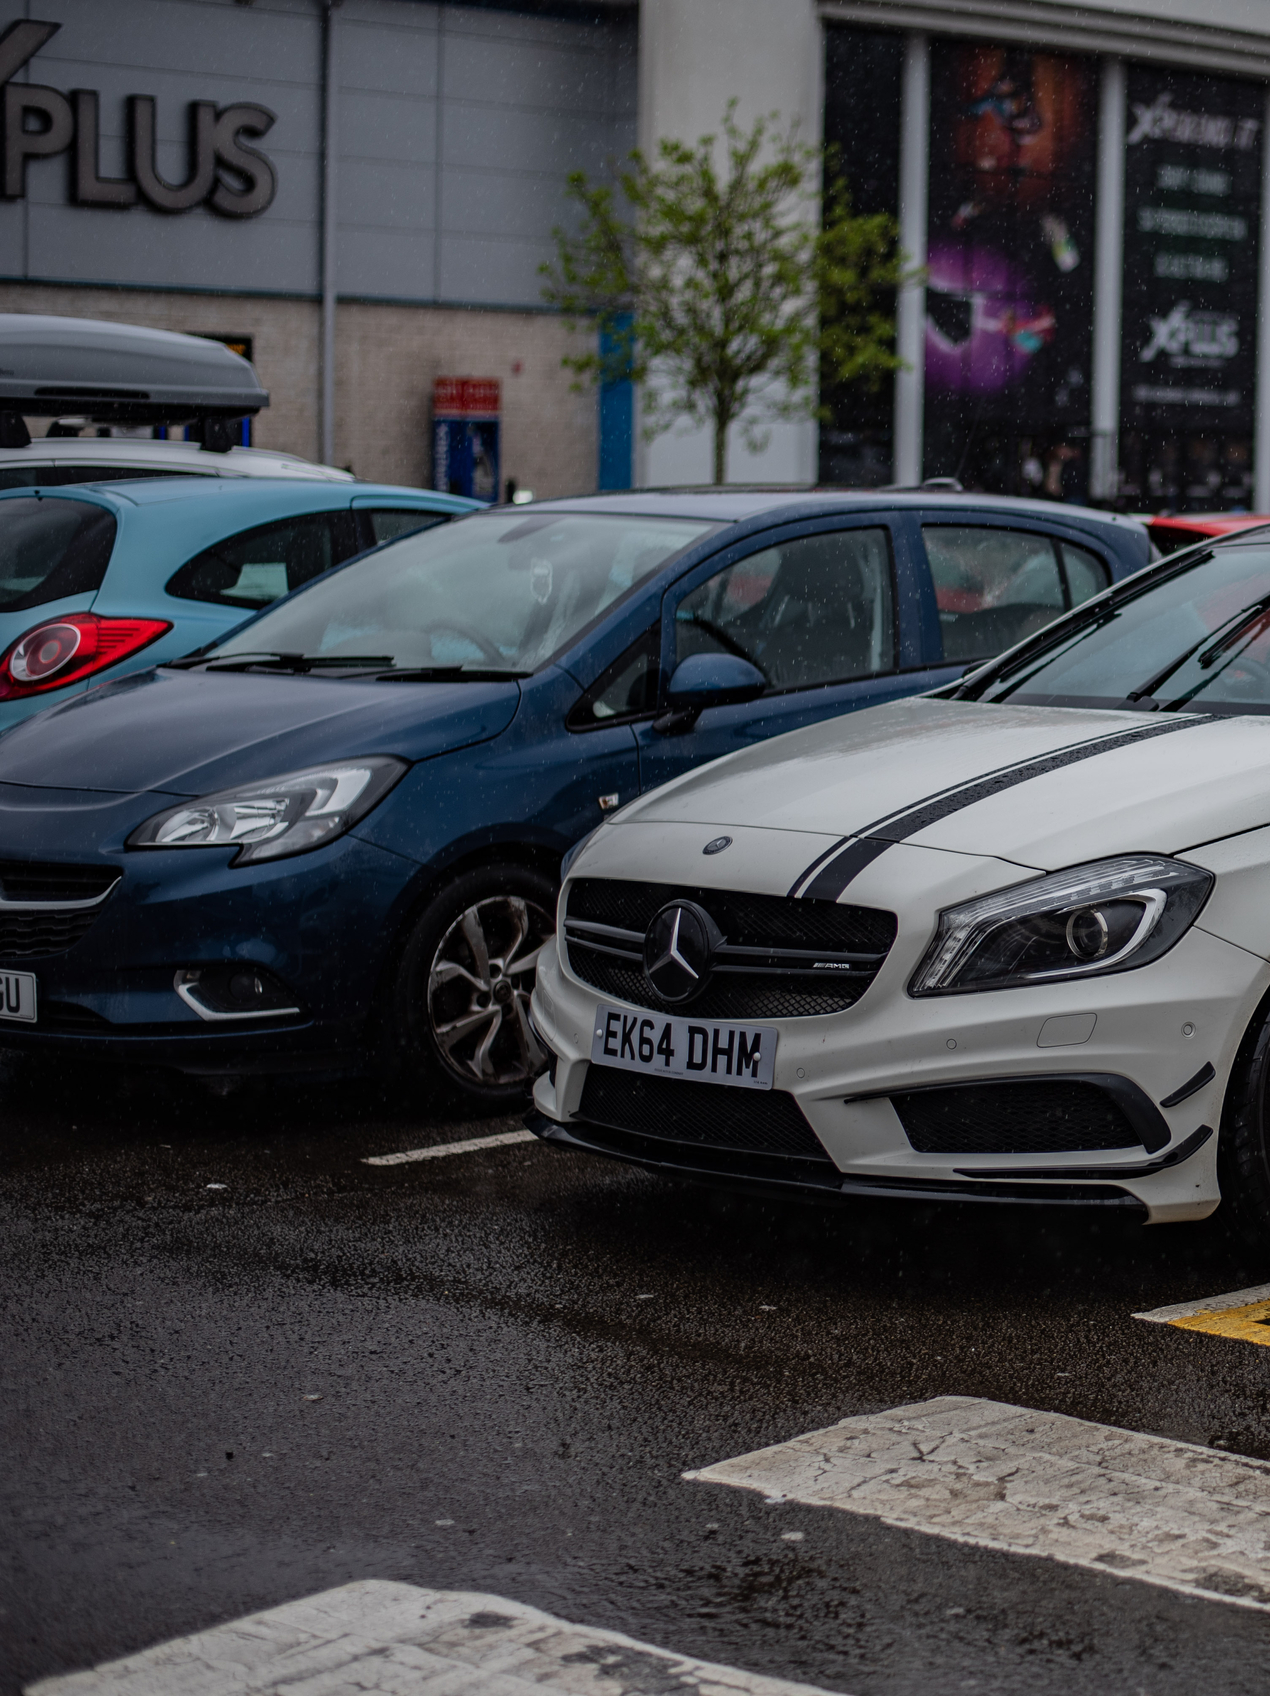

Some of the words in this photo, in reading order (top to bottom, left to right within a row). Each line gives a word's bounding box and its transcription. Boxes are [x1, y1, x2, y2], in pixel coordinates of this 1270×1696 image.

[0, 976, 20, 1014] U
[603, 1011, 675, 1067] EK64
[686, 1025, 762, 1078] DHM
